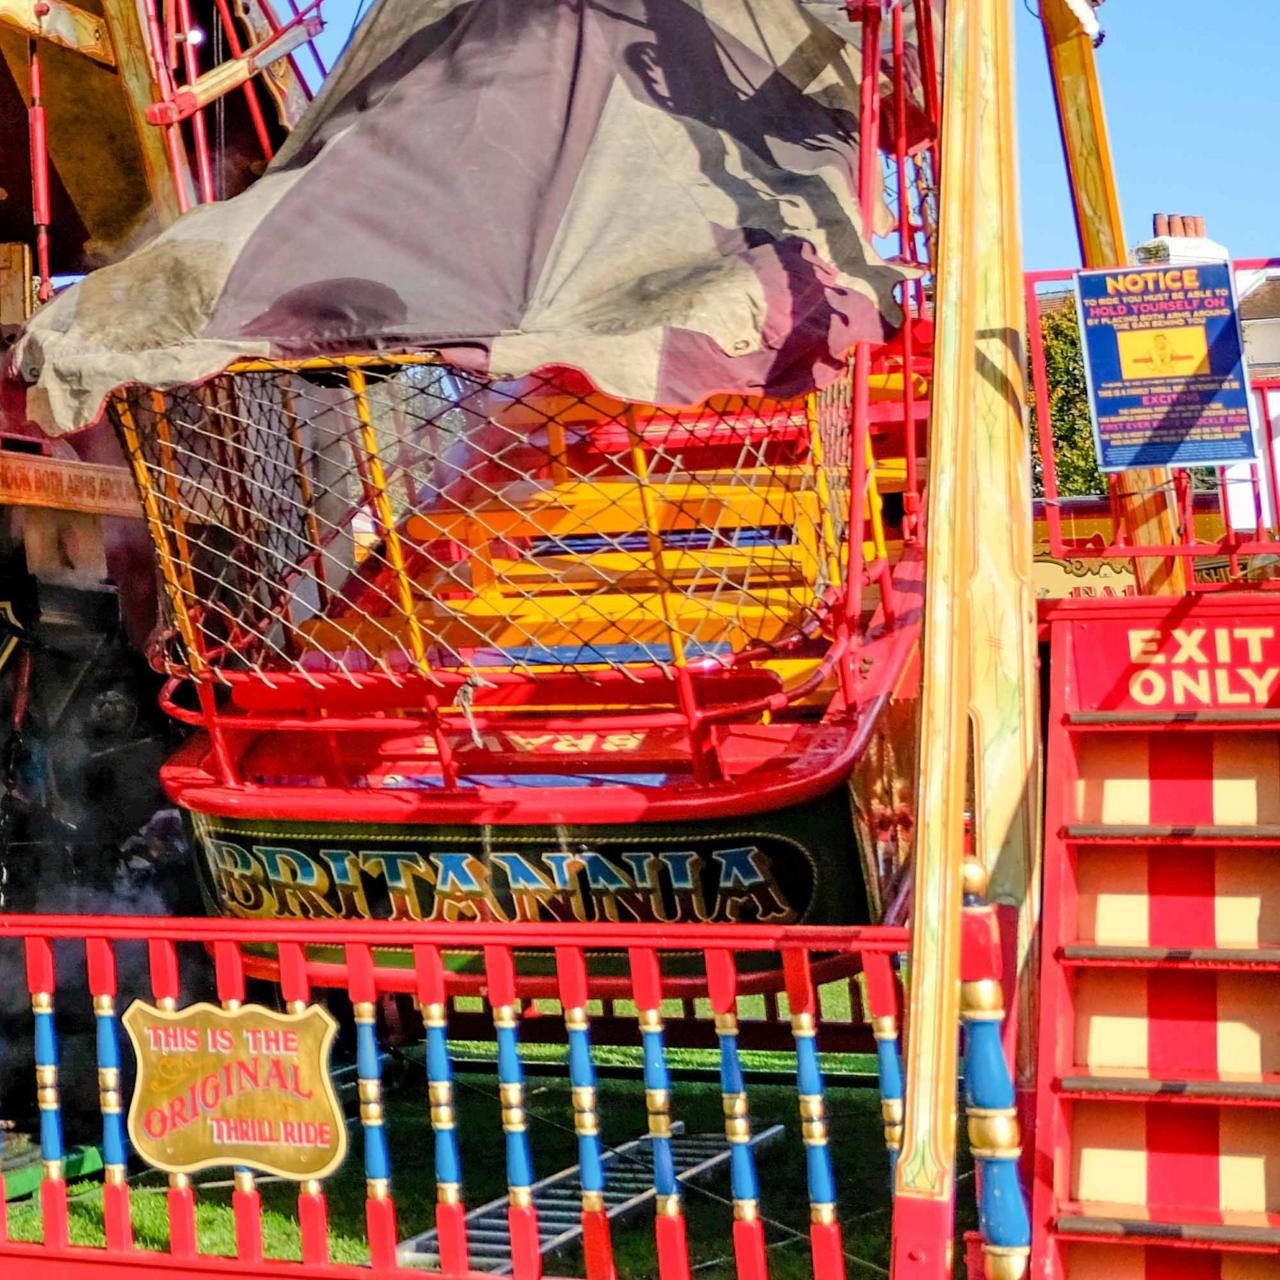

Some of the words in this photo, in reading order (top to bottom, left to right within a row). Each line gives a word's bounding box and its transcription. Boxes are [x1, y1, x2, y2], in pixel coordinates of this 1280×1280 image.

[1083, 298, 1097, 306] TO
[1123, 295, 1142, 303] YOU
[1187, 290, 1212, 298] ABLE
[1214, 289, 1228, 297] TO
[1105, 269, 1199, 294] NOTICE
[1090, 304, 1127, 316] HOLD
[1131, 298, 1200, 313] YOURSELF
[1204, 297, 1225, 308] ON
[1127, 628, 1274, 664] EXIT
[1128, 668, 1280, 706] ONLY
[209, 838, 794, 921] BRITANNIA
[144, 1024, 201, 1053] THIS
[207, 1027, 234, 1055] IS
[244, 1028, 299, 1057] THE
[143, 1057, 314, 1141] ORIGINAL
[208, 1116, 280, 1145] THRILL
[281, 1119, 334, 1147] RIDE
